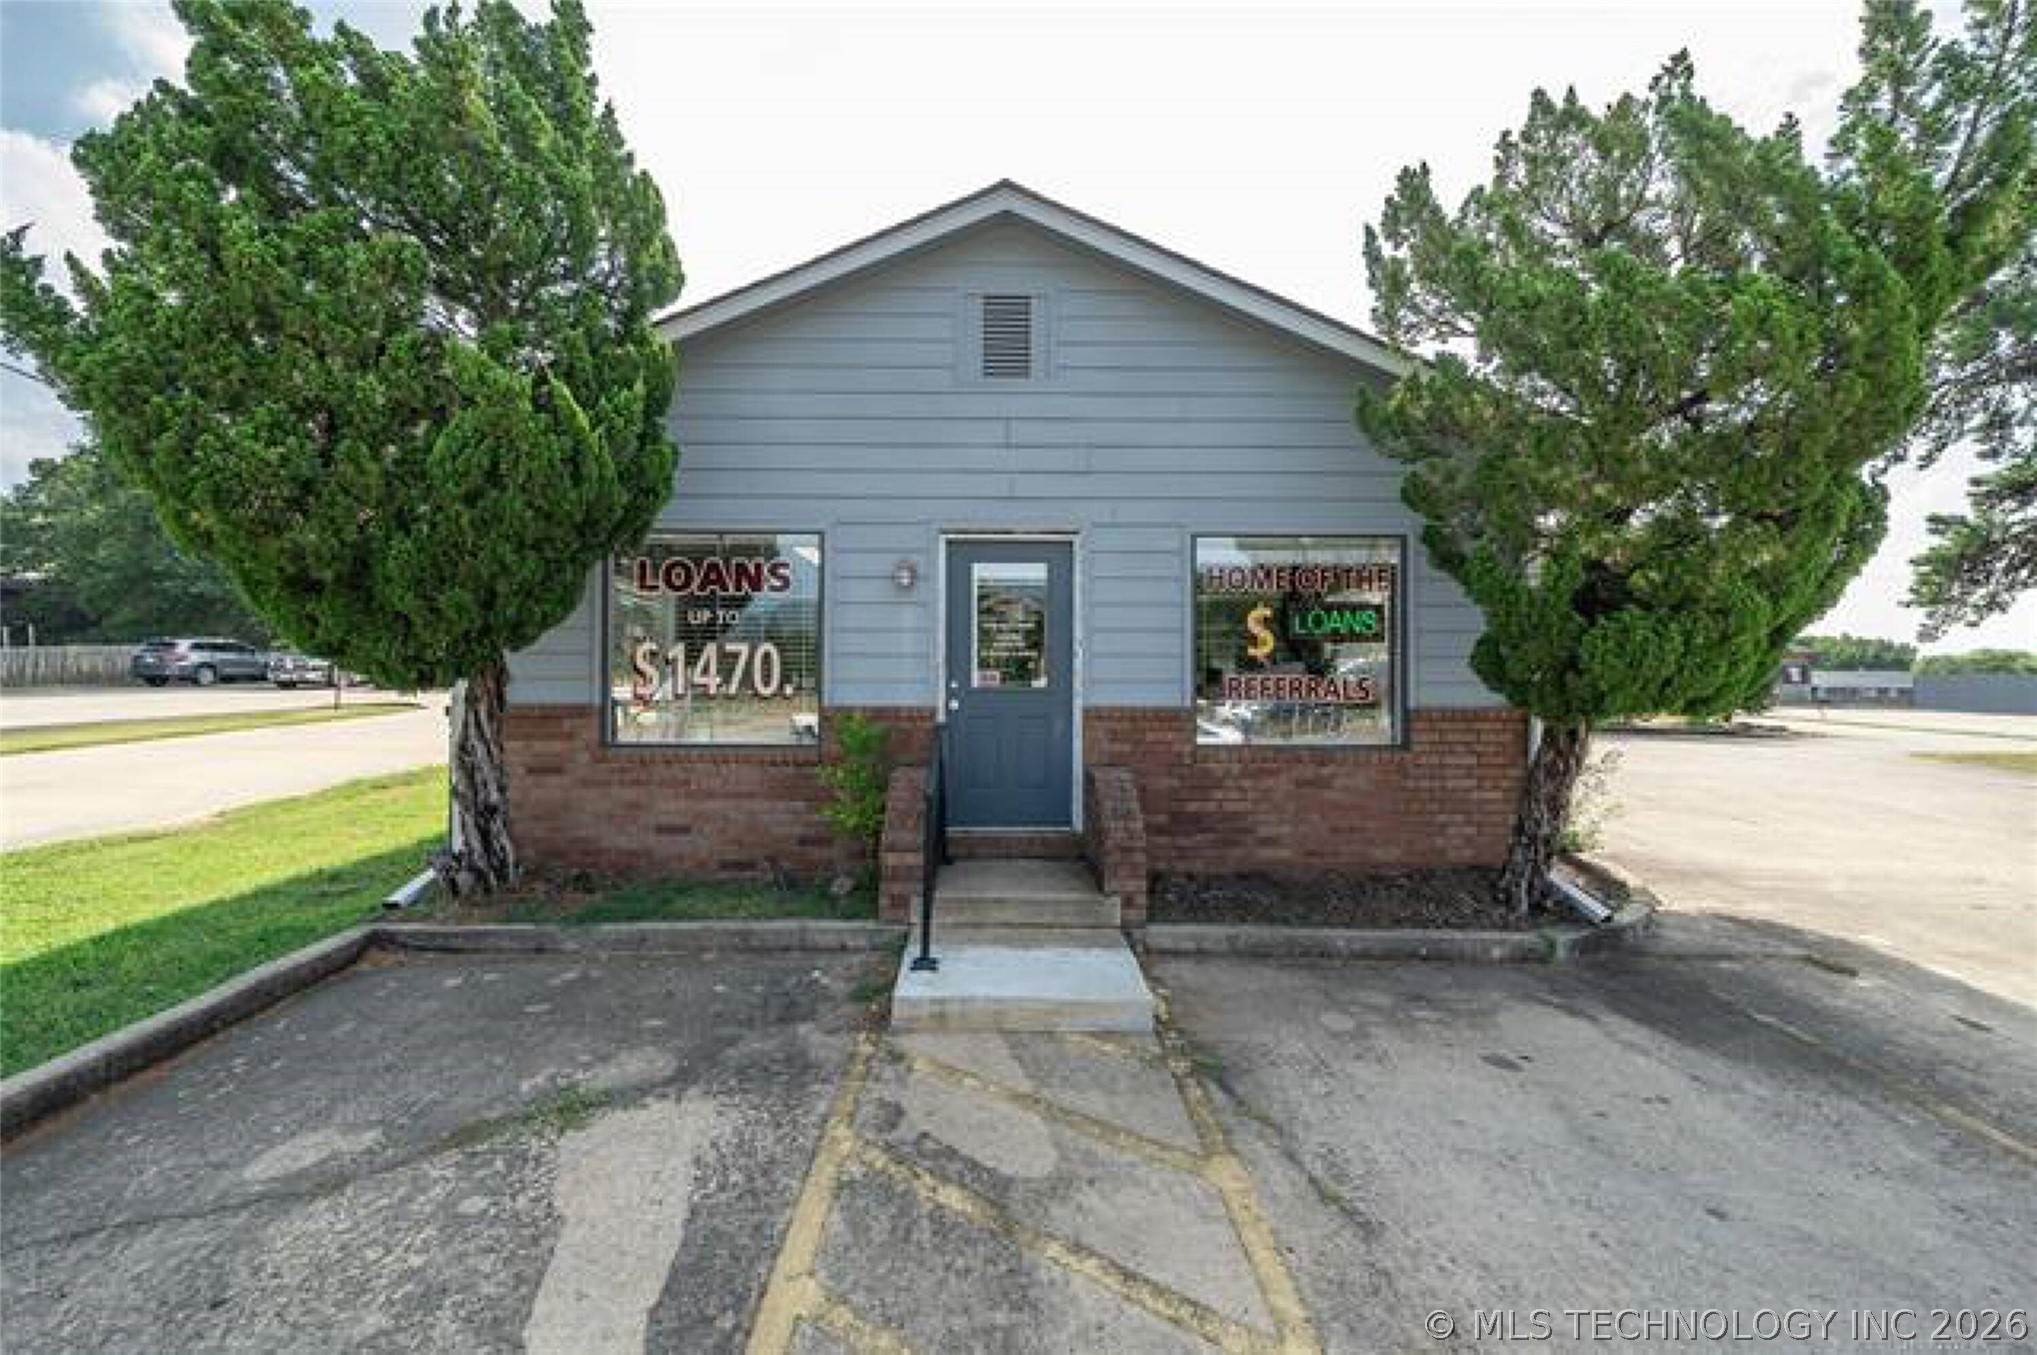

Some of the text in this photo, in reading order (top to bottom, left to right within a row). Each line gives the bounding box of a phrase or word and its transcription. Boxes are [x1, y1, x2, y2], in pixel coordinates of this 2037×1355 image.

[633, 556, 793, 595] LOANS
[1207, 564, 1389, 592] HOME OF THE
[687, 610, 740, 625] UP TO
[1246, 602, 1275, 663] $
[1293, 609, 1377, 635] LOANS
[632, 636, 795, 707] $1470.
[1225, 673, 1376, 703] REFERRALS
